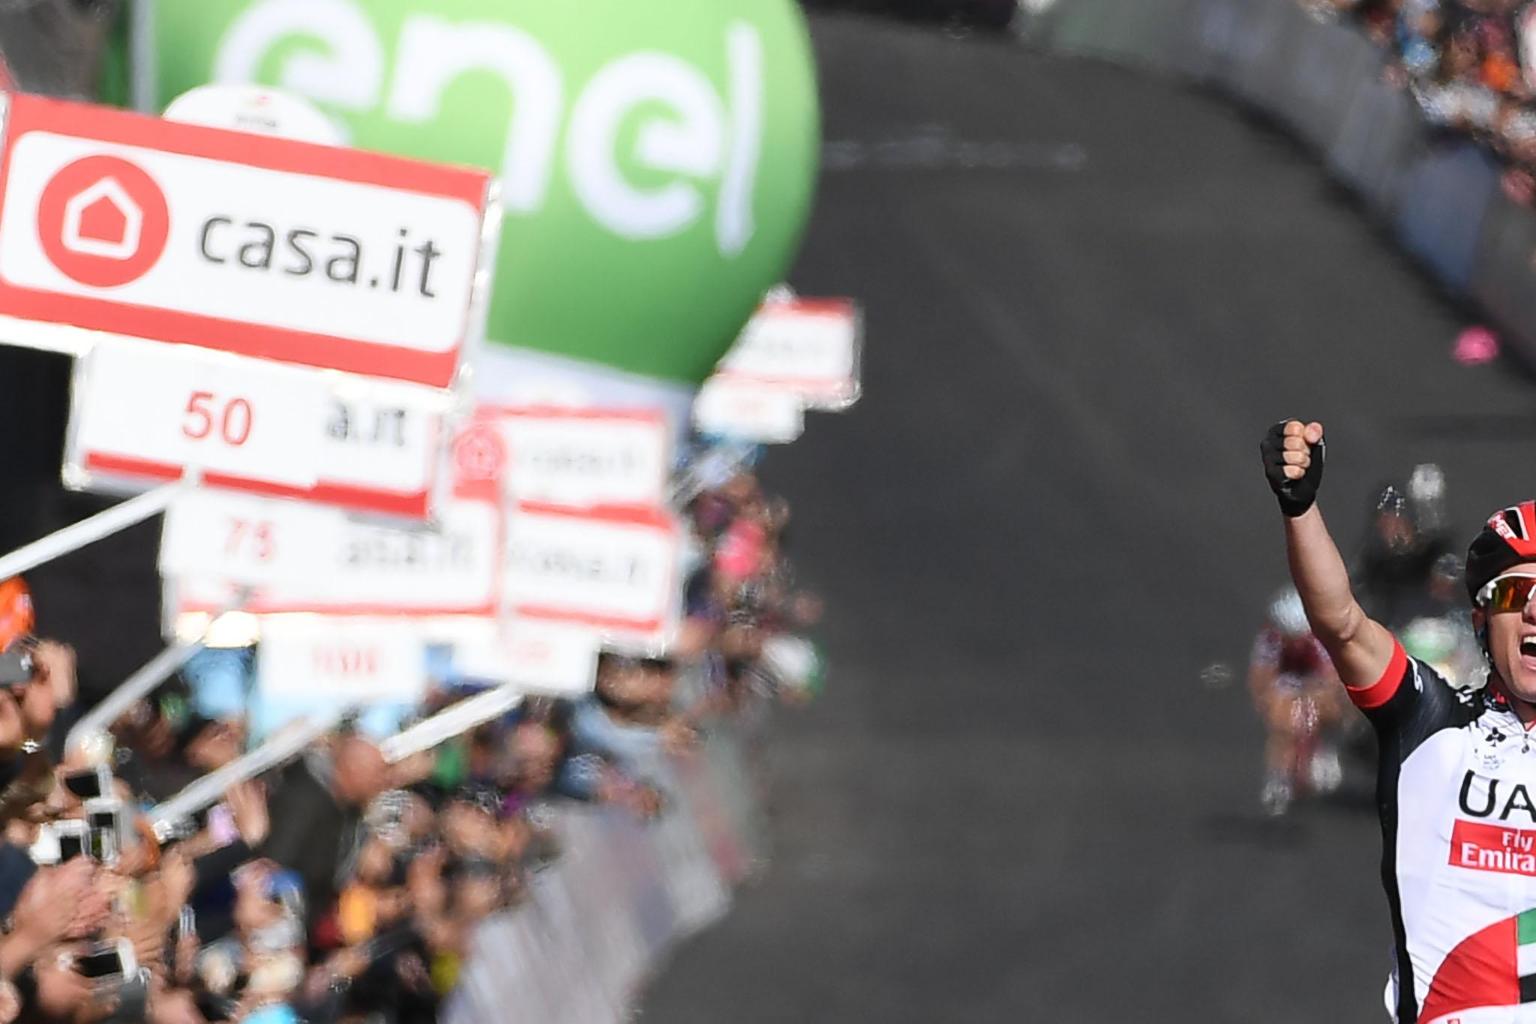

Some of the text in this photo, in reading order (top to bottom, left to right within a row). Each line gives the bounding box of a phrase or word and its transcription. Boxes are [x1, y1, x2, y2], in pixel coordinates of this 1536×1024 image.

[199, 213, 444, 299] casa.it
[182, 390, 254, 447] 50
[1502, 830, 1534, 852] Fly
